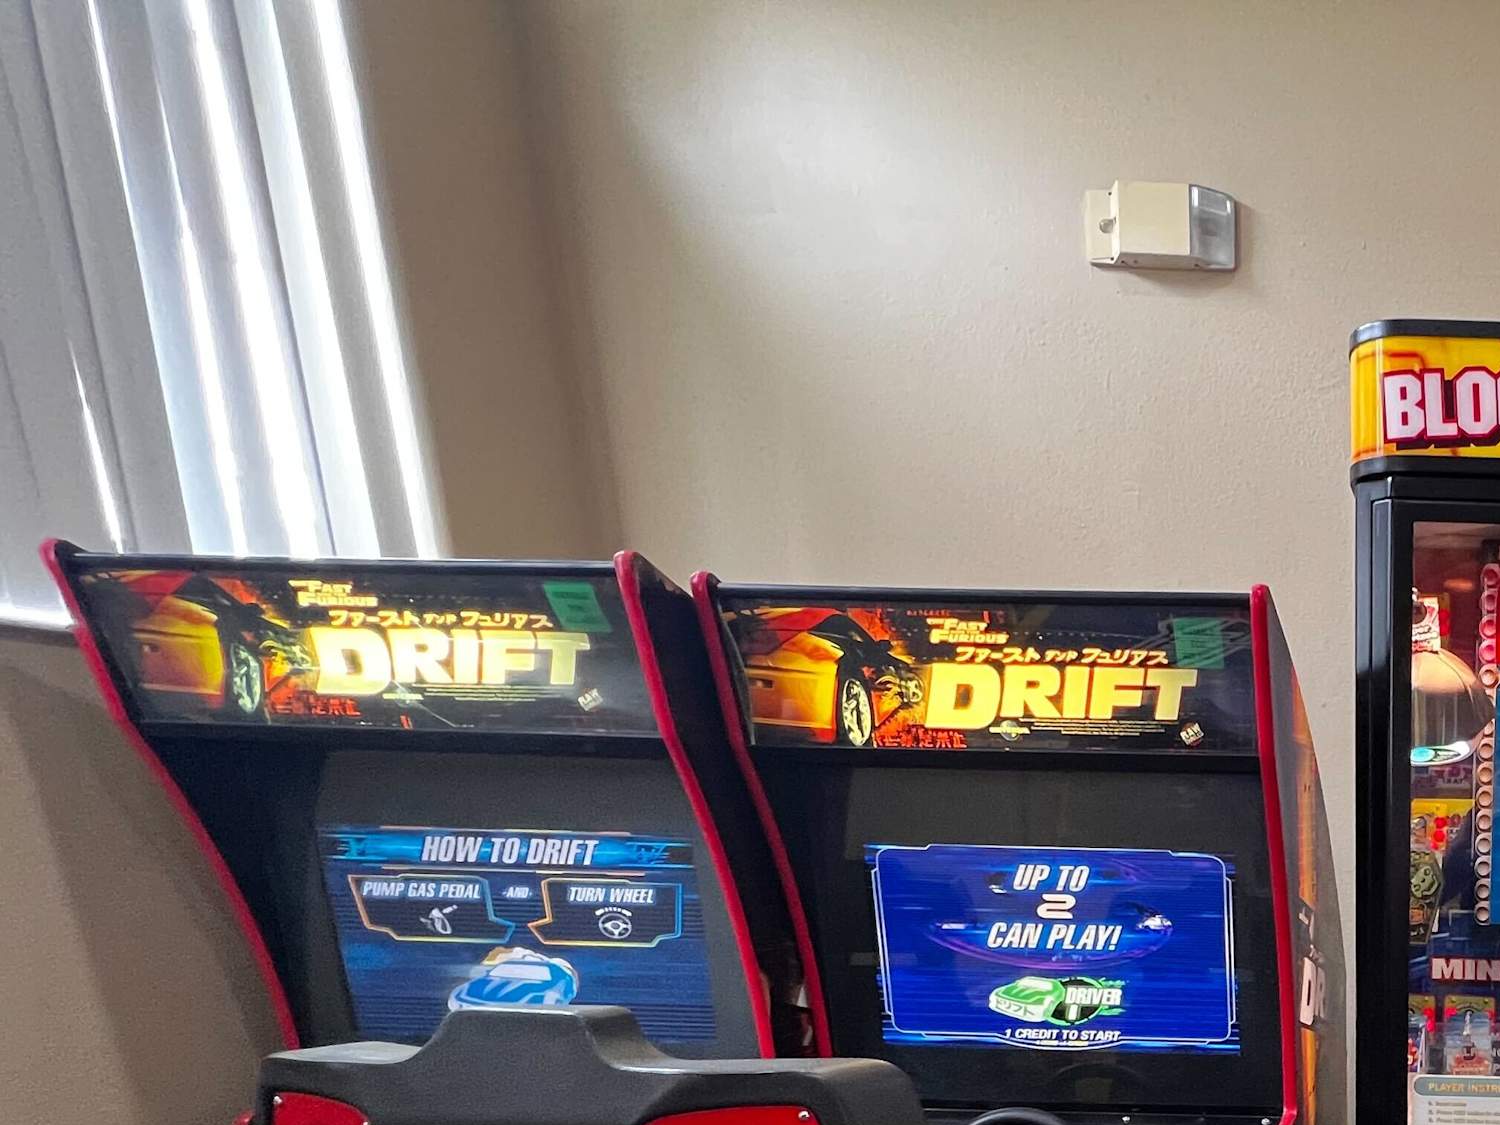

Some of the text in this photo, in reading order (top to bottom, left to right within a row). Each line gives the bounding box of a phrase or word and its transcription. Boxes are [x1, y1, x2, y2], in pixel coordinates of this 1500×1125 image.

[926, 618, 988, 631] FAST
[929, 629, 1010, 645] FURIOUS
[313, 627, 591, 695] DRIFT
[955, 646, 1042, 663] ファースト
[924, 662, 1199, 731] DRIFT
[421, 836, 599, 866] HOW TO DRIFT
[1013, 864, 1090, 892] UP TO
[362, 881, 481, 899] PUMP GAS PEDAL
[568, 886, 654, 903] TURN WHEEL
[1036, 893, 1077, 920] 2
[987, 922, 1123, 951] CAN PLAY!
[1065, 986, 1123, 1006] DRIVER
[1004, 1028, 1122, 1041] 1 CREDIT TO START
[1428, 1082, 1466, 1093] PLAYER
